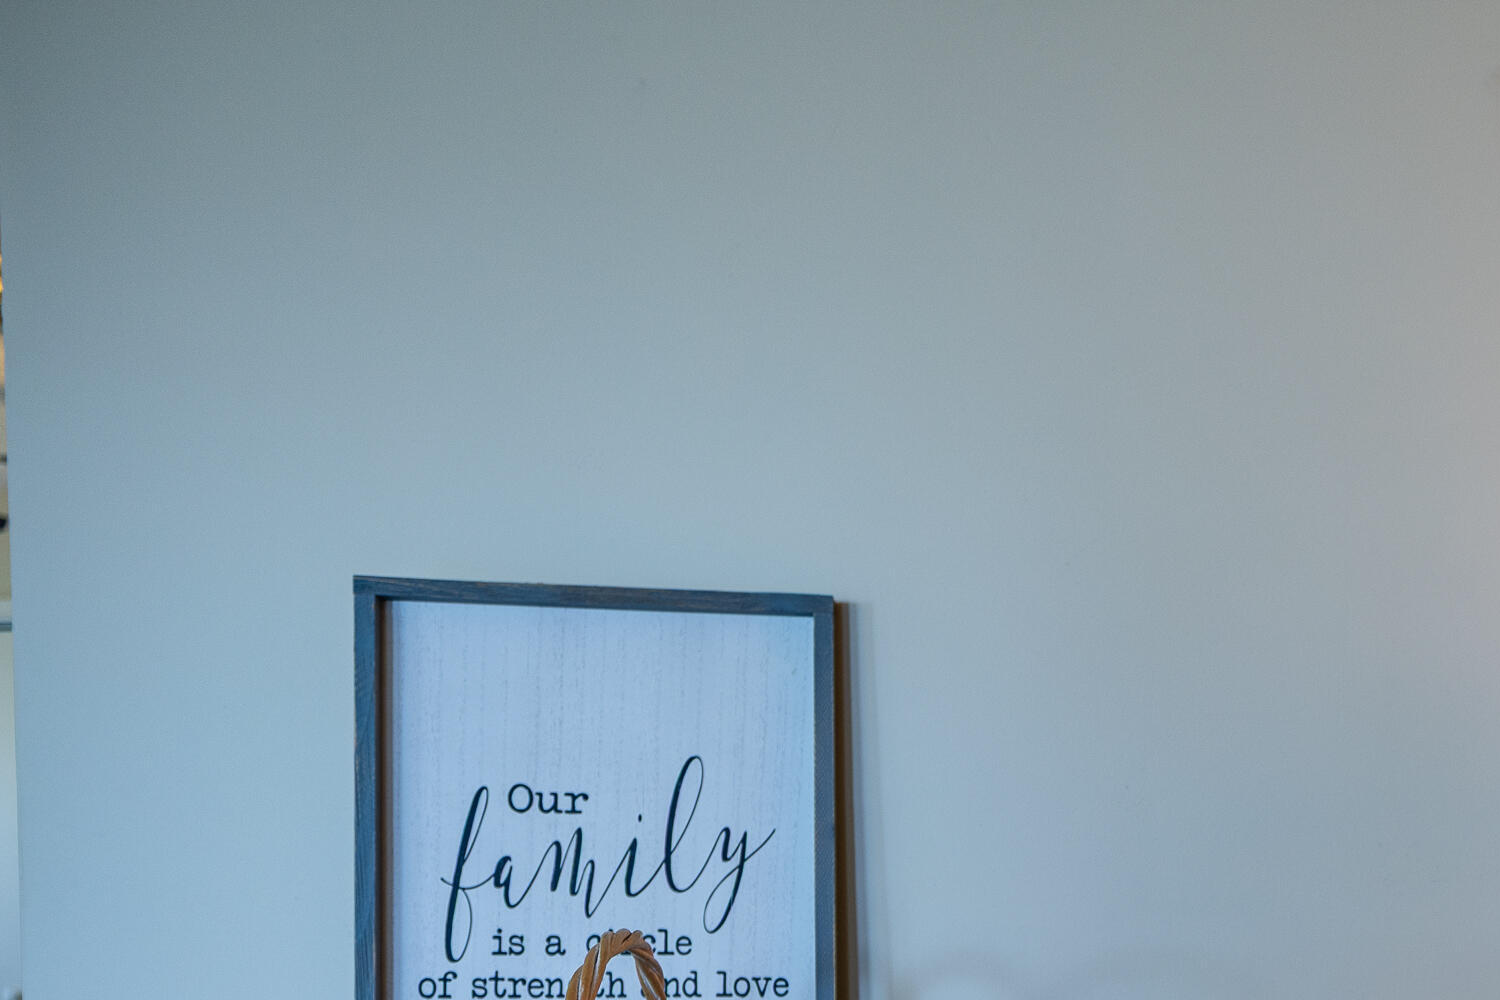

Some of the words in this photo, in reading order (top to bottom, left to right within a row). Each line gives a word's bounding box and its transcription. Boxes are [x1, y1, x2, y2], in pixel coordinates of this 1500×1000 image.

[507, 783, 590, 815] Our
[440, 755, 776, 963] family
[491, 929, 526, 956] is
[545, 935, 566, 956] a
[586, 929, 693, 956] ccle
[418, 971, 458, 999] of
[471, 970, 627, 999] strenh
[640, 970, 702, 999] nd
[716, 970, 790, 998] love
